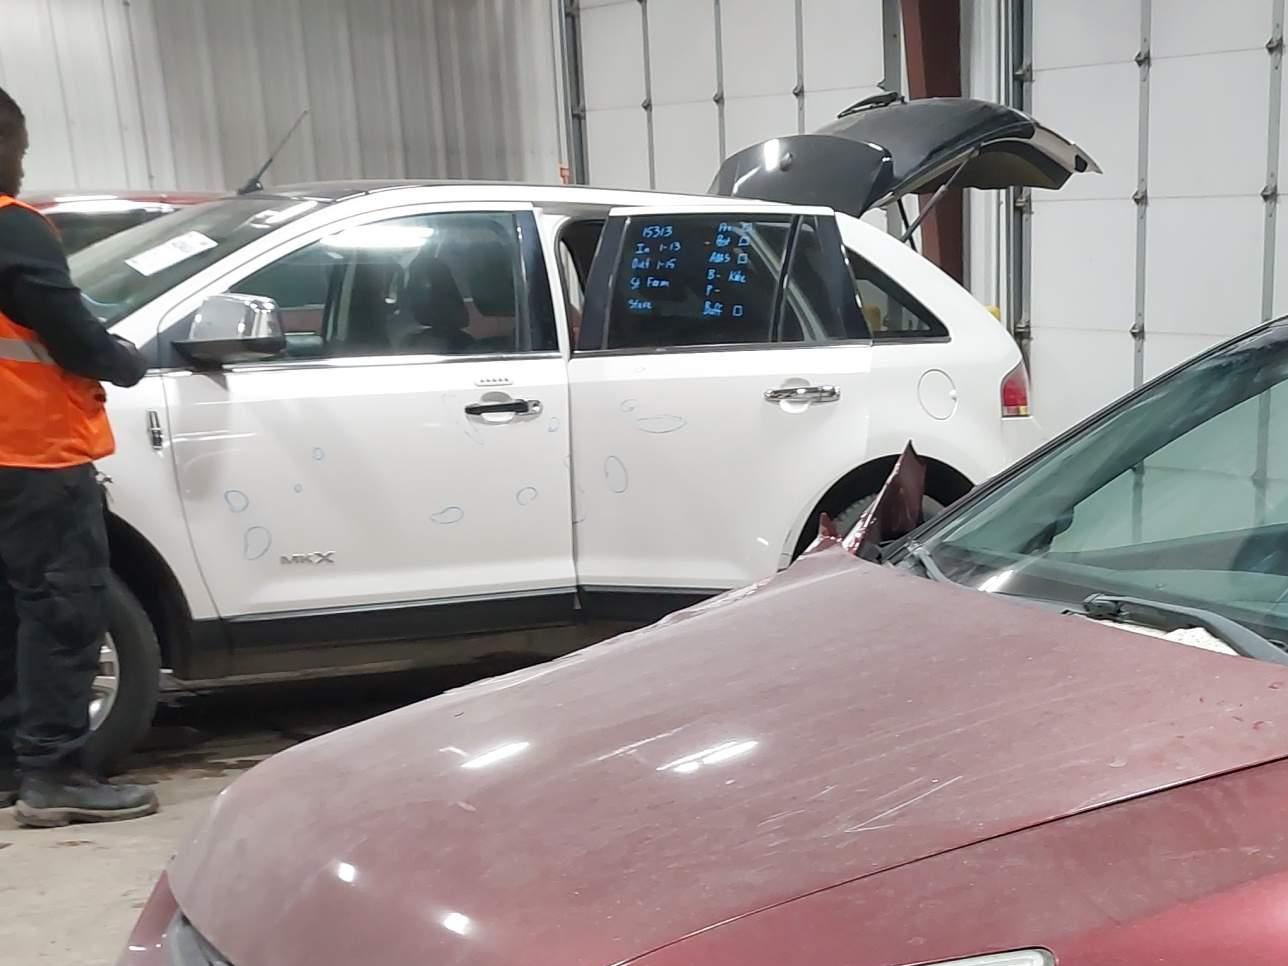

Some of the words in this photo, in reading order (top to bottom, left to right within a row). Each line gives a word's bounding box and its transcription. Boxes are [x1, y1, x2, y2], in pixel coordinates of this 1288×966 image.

[642, 225, 673, 238] 15313
[659, 241, 681, 252] 1-13
[656, 257, 677, 270] 1-15
[280, 551, 336, 565] MKX
